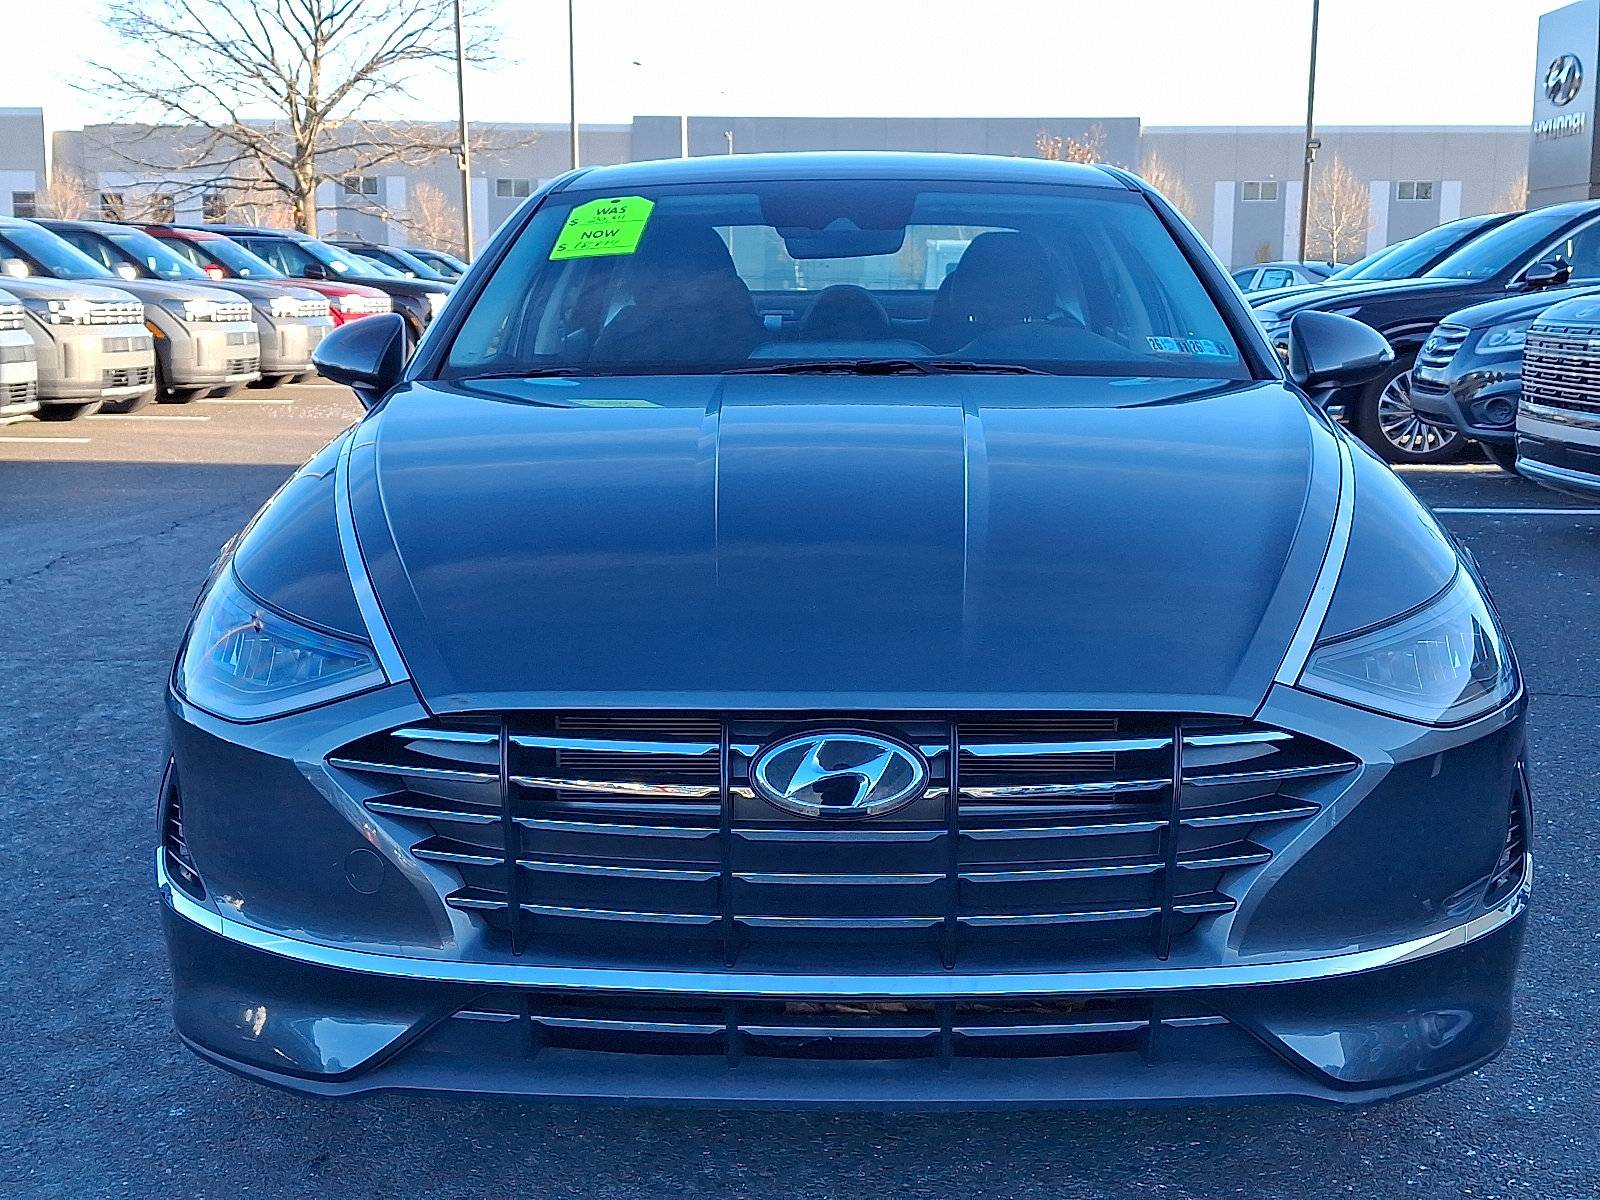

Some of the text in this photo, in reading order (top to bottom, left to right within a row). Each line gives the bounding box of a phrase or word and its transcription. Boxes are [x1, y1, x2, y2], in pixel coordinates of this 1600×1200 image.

[596, 206, 627, 215] WAS
[581, 229, 620, 239] NOW
[1149, 338, 1163, 350] 26
[1189, 341, 1204, 353] 26
